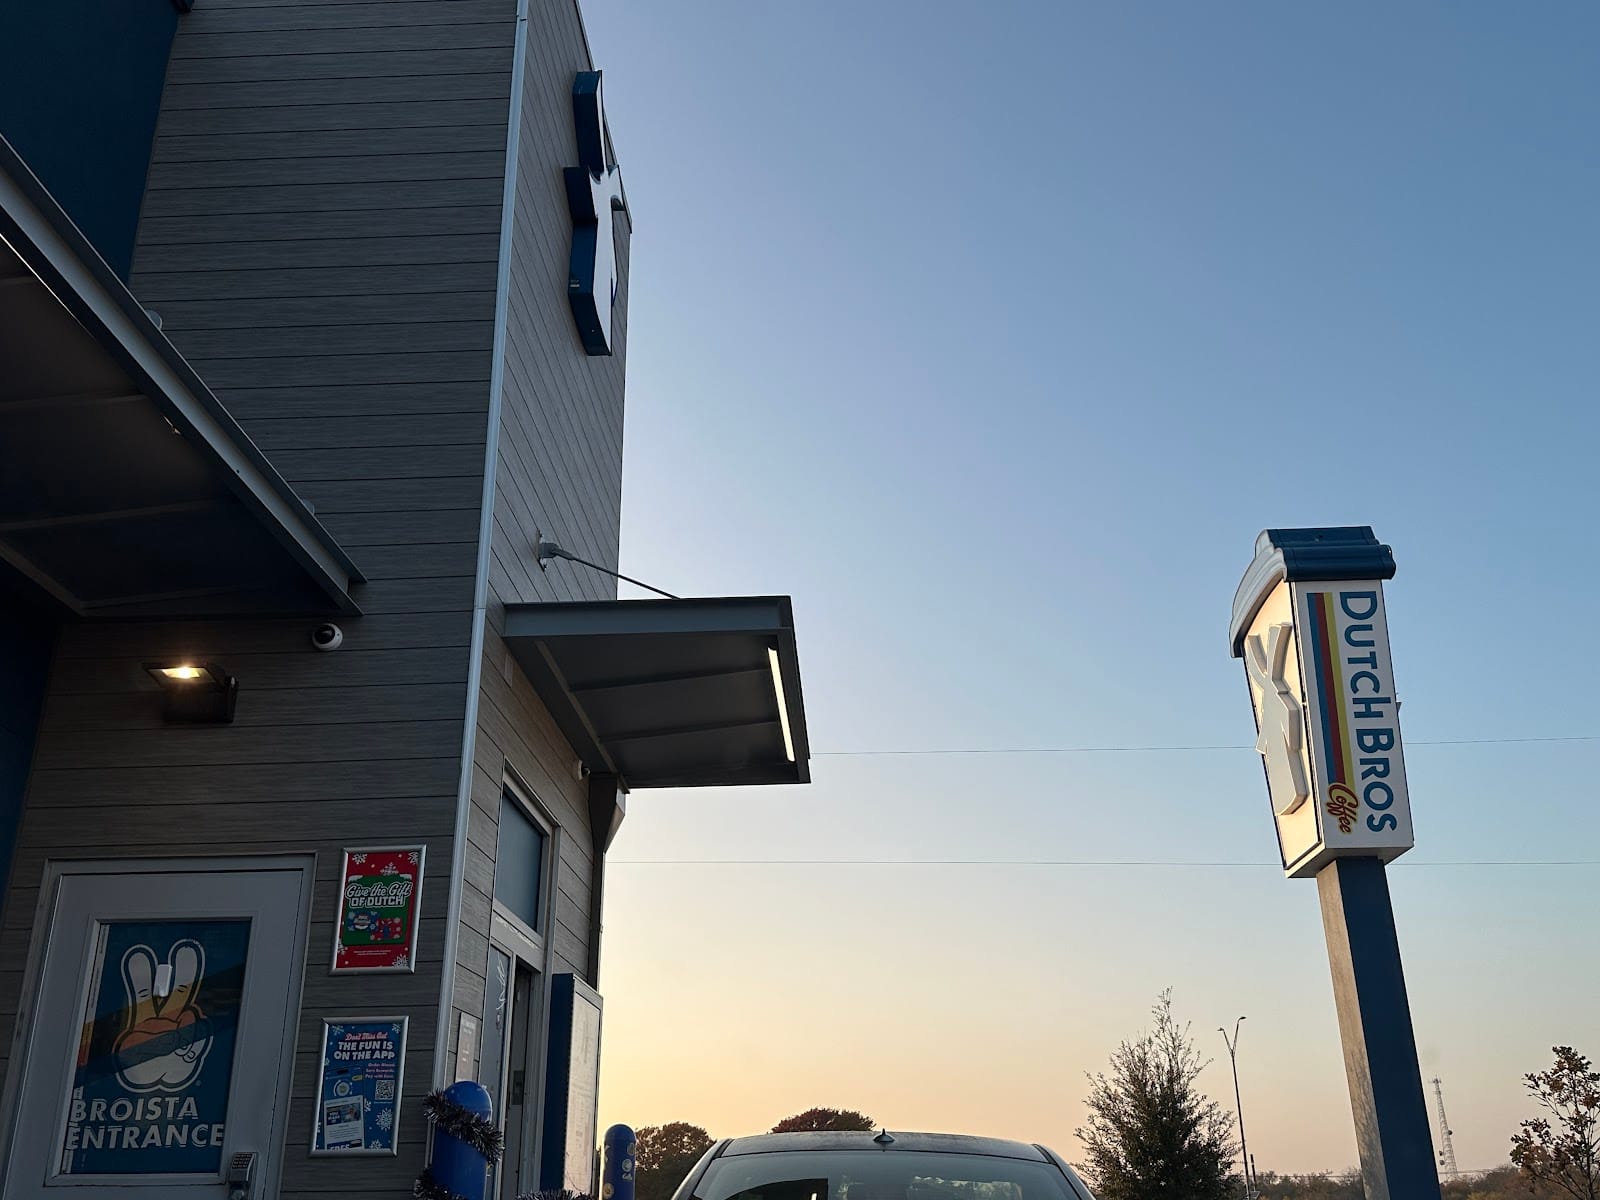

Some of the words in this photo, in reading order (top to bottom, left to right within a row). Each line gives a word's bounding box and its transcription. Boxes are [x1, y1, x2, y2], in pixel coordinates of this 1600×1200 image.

[1340, 591, 1391, 718] DUTCH
[1356, 728, 1397, 833] BROS
[1327, 783, 1358, 834] Coffee
[347, 884, 369, 897] Give
[370, 884, 386, 897] the
[389, 883, 412, 897] Gift
[351, 897, 365, 906] OF
[367, 896, 403, 906] DUTCH
[334, 1051, 350, 1060] ON
[352, 1051, 372, 1060] THE
[373, 1050, 395, 1060] APP
[338, 1041, 358, 1051] THE
[359, 1041, 380, 1050] FUN
[382, 1041, 393, 1050] IS
[69, 1096, 198, 1122] BROISTA
[66, 1124, 224, 1150] ENTRANCE
